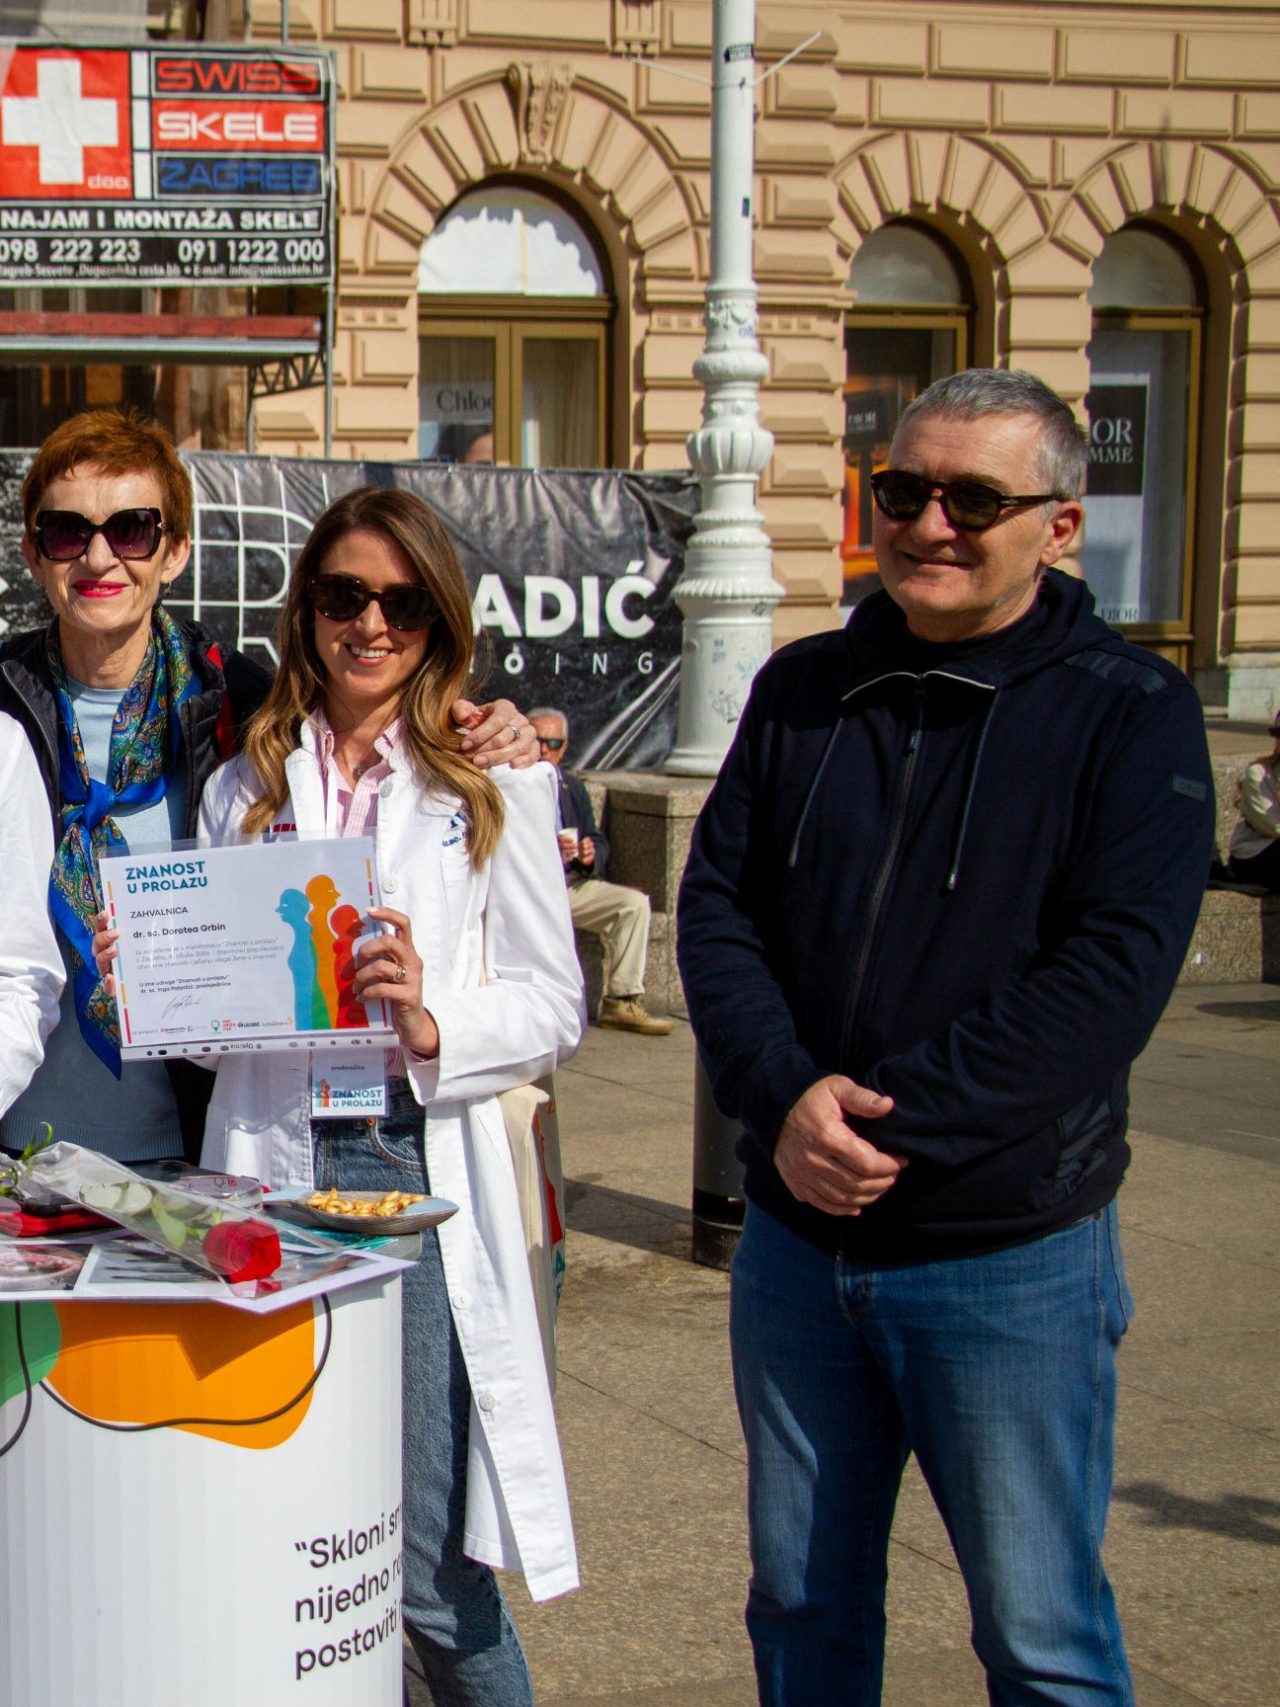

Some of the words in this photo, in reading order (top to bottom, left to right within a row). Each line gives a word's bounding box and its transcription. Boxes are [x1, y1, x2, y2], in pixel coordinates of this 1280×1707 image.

[157, 60, 317, 91] SWISS
[158, 111, 317, 141] SKELE
[160, 161, 318, 191] ZAGREB
[1, 209, 89, 230] NAJAM
[97, 209, 105, 229] I
[114, 206, 234, 230] MONTAŽA
[240, 209, 319, 230] SKELE
[50, 239, 93, 263] 222
[99, 239, 142, 263] 223
[178, 239, 217, 263] 091
[227, 238, 279, 263] 1222
[284, 238, 325, 263] 000
[436, 389, 492, 412] Chlo
[472, 560, 656, 640] ADIĆ
[125, 861, 206, 881] ZNANOST
[127, 883, 138, 894] U
[141, 876, 208, 893] PROLAZU
[130, 906, 188, 919] ZAHVALNICA
[133, 930, 146, 939] dr.
[162, 926, 199, 936] Dorotea
[200, 922, 226, 933] Grbin
[332, 1089, 382, 1098] ZNANOST
[341, 1099, 383, 1107] PROLAZU
[294, 1567, 390, 1624] nijedno
[295, 1600, 397, 1680] postaviti
